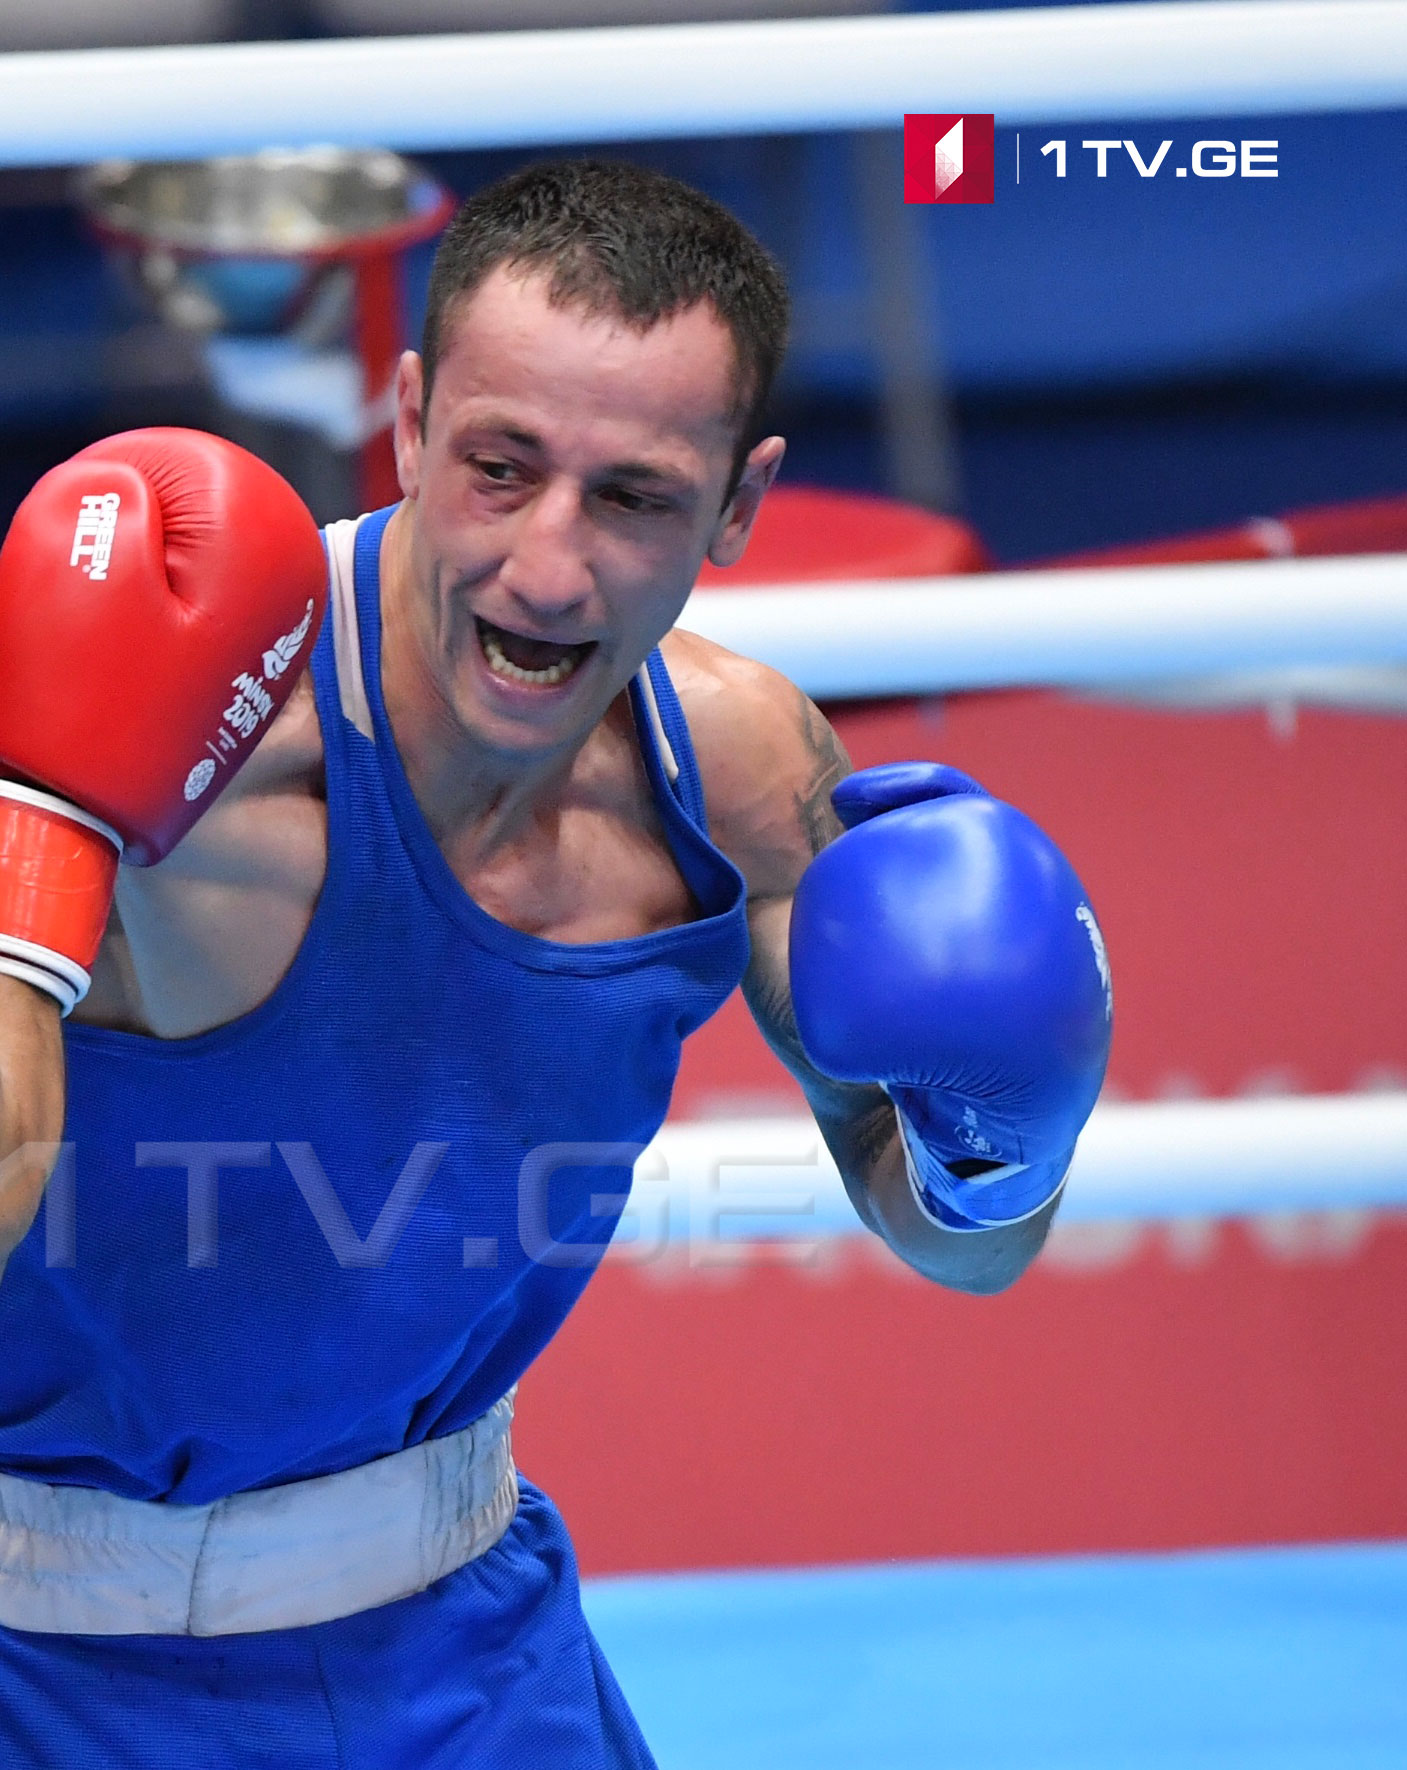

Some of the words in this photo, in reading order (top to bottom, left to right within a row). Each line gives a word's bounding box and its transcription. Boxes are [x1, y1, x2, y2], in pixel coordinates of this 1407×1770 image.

[69, 494, 103, 568] HILL
[88, 491, 121, 581] GREEN
[222, 694, 260, 739] 2019
